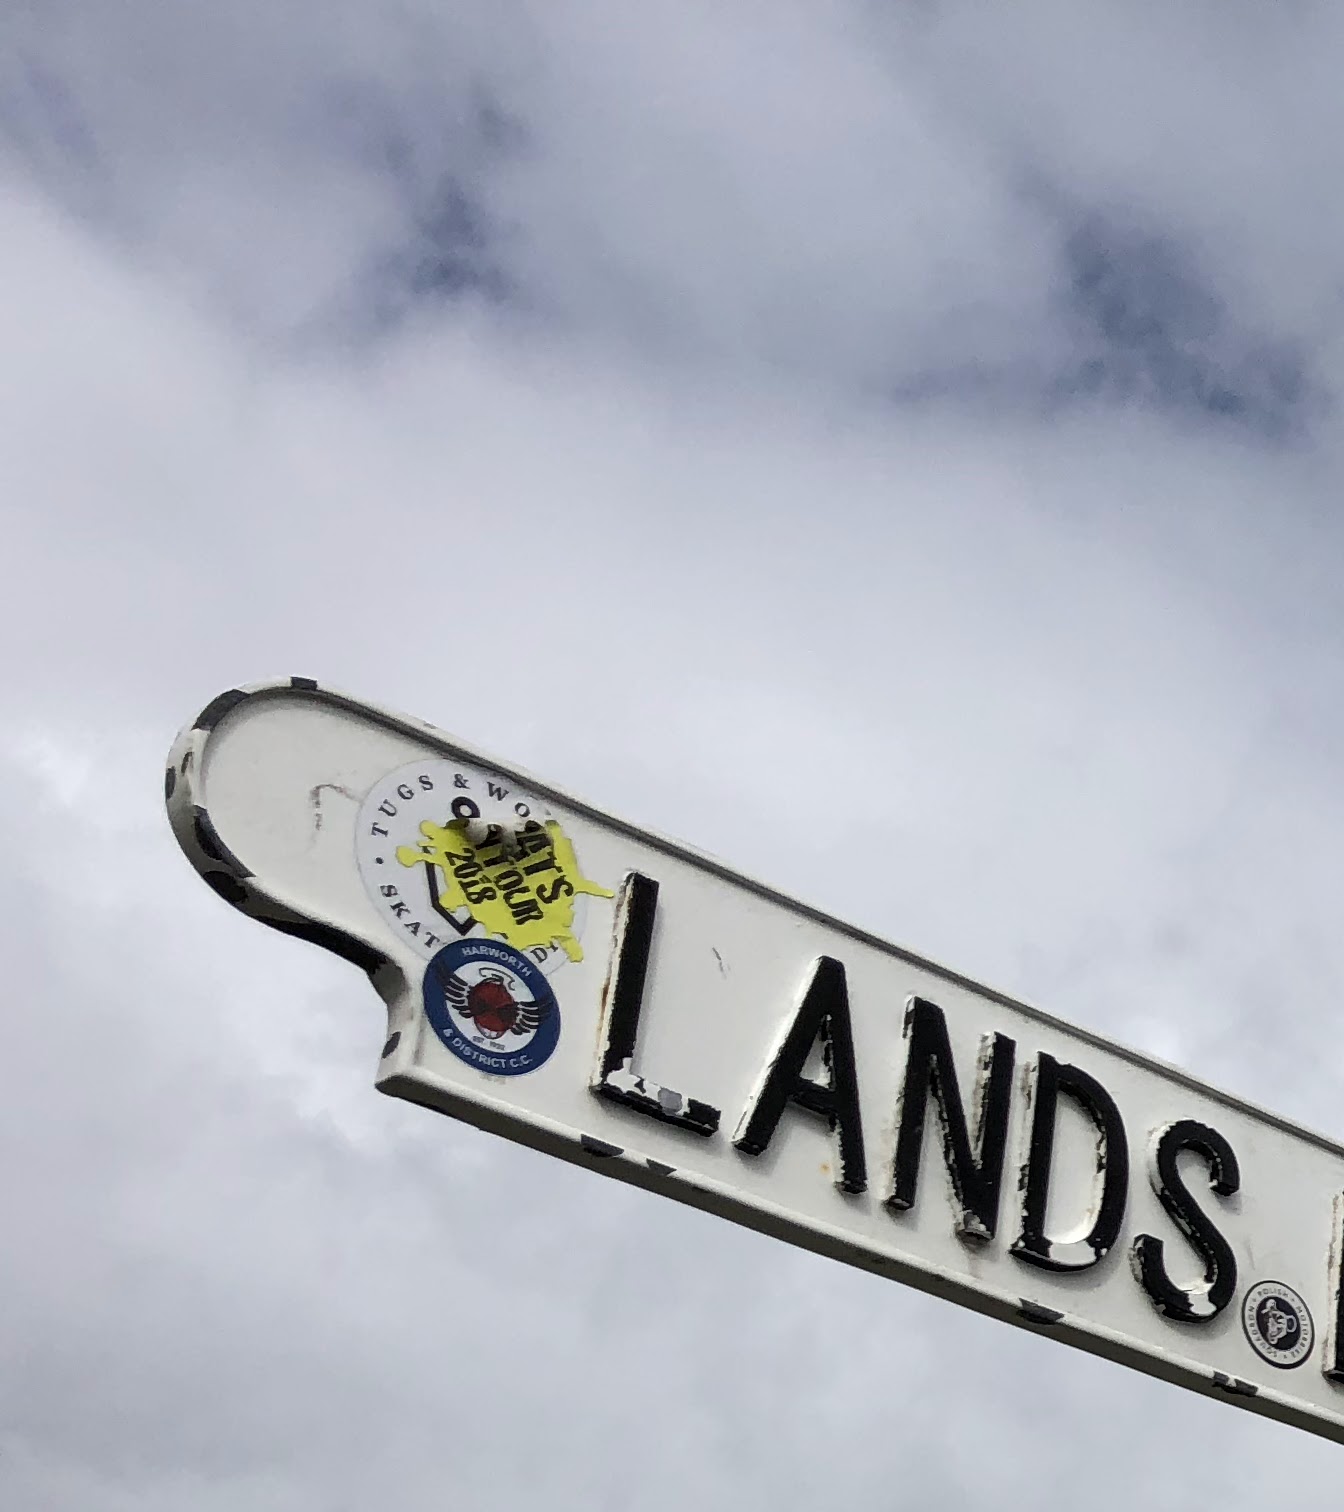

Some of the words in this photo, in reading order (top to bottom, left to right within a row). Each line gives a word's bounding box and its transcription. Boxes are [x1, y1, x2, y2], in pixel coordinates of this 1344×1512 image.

[371, 774, 434, 838] TUGS
[453, 773, 470, 789] &
[445, 850, 498, 905] 2018
[462, 946, 533, 977] HARWORTH
[452, 1037, 507, 1069] DISTRICT
[509, 1055, 533, 1068] C.C.
[588, 870, 1240, 1324] LANDS
